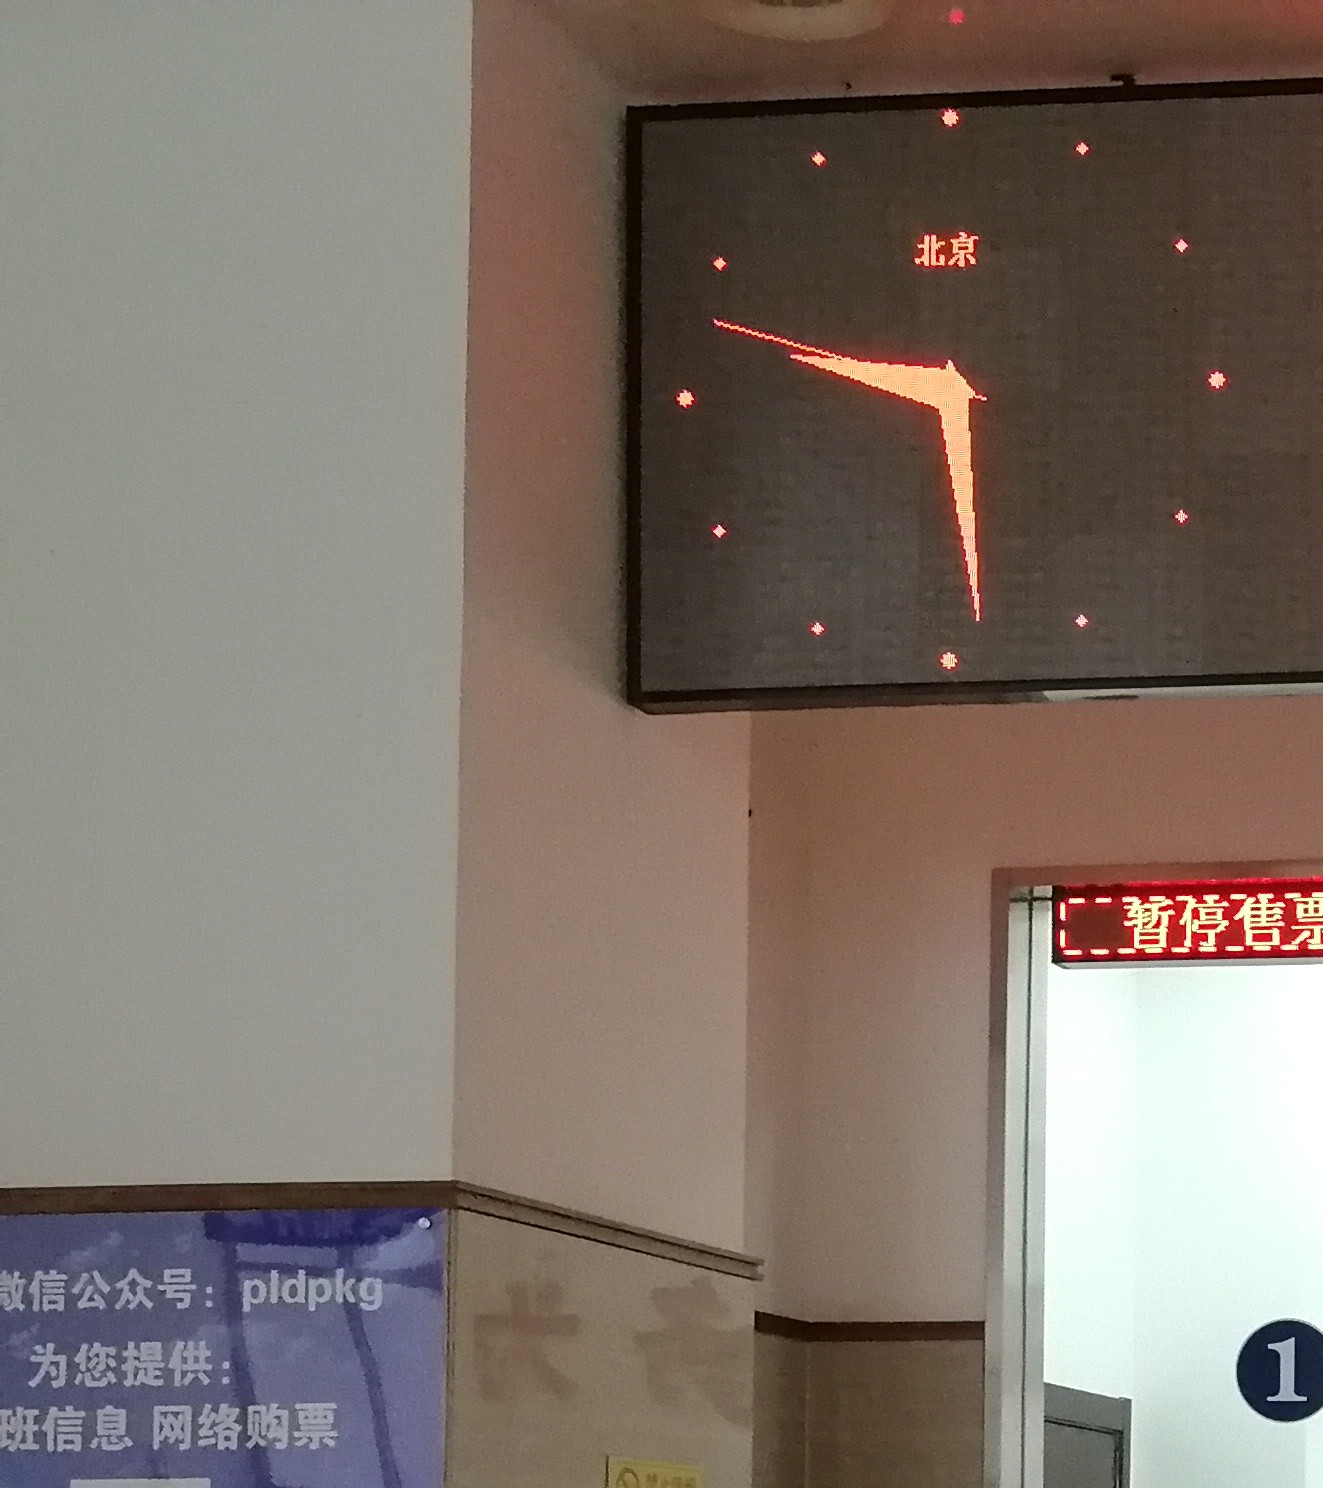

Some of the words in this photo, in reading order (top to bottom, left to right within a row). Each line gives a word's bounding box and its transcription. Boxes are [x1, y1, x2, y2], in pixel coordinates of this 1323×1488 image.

[913, 230, 980, 269] 北京
[242, 1267, 385, 1312] pldpkg
[1265, 1336, 1308, 1402] 1
[152, 1401, 339, 1451] 网络购票
